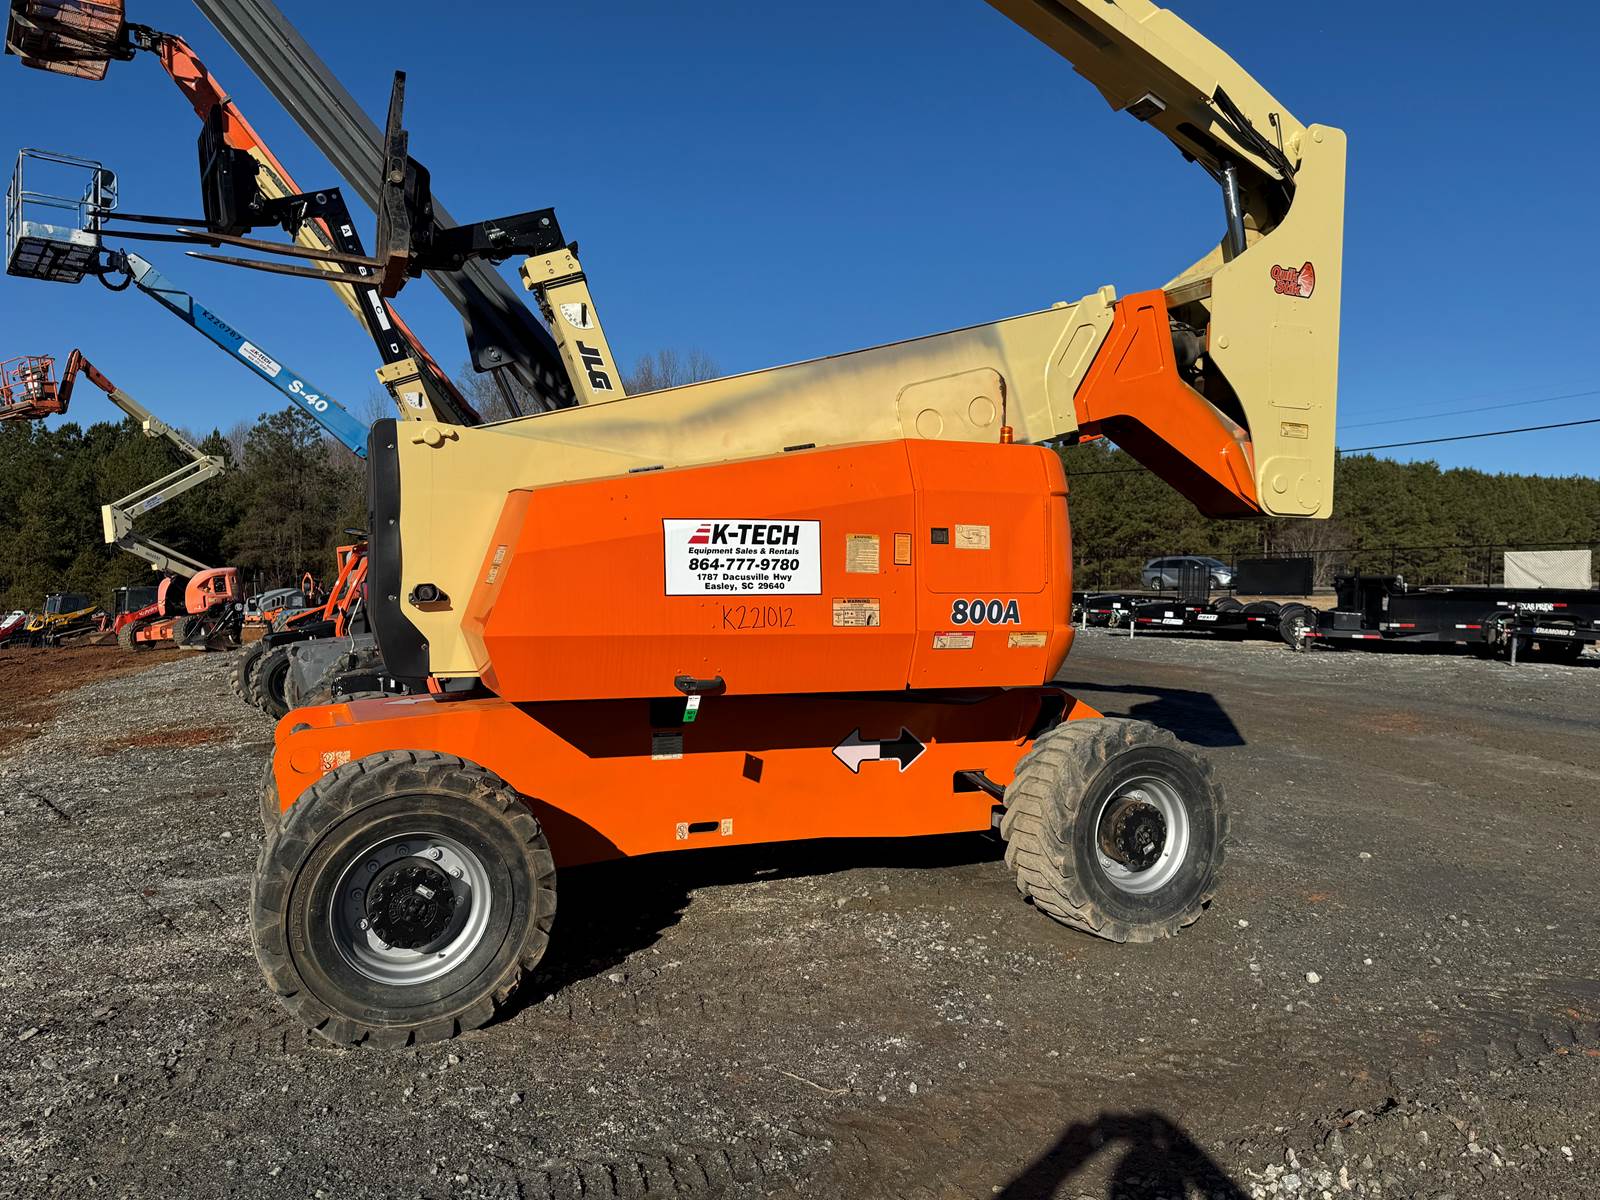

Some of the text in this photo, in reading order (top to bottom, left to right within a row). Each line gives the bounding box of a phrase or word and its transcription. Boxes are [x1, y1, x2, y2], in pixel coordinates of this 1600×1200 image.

[342, 227, 350, 235] A
[359, 266, 367, 275] B
[375, 305, 383, 314] C
[390, 343, 399, 354] D
[575, 340, 614, 391] JLG
[288, 379, 328, 412] S-40
[711, 523, 800, 545] K-TECH
[688, 547, 733, 555] Equipment
[735, 547, 758, 555] Sales
[760, 547, 766, 555] &
[688, 558, 800, 571] 864-777-9780
[696, 573, 792, 582] 1787 Dacusville Hwy
[704, 582, 738, 591] Easley,
[951, 598, 1021, 625] 800A
[722, 604, 796, 631] K221012
